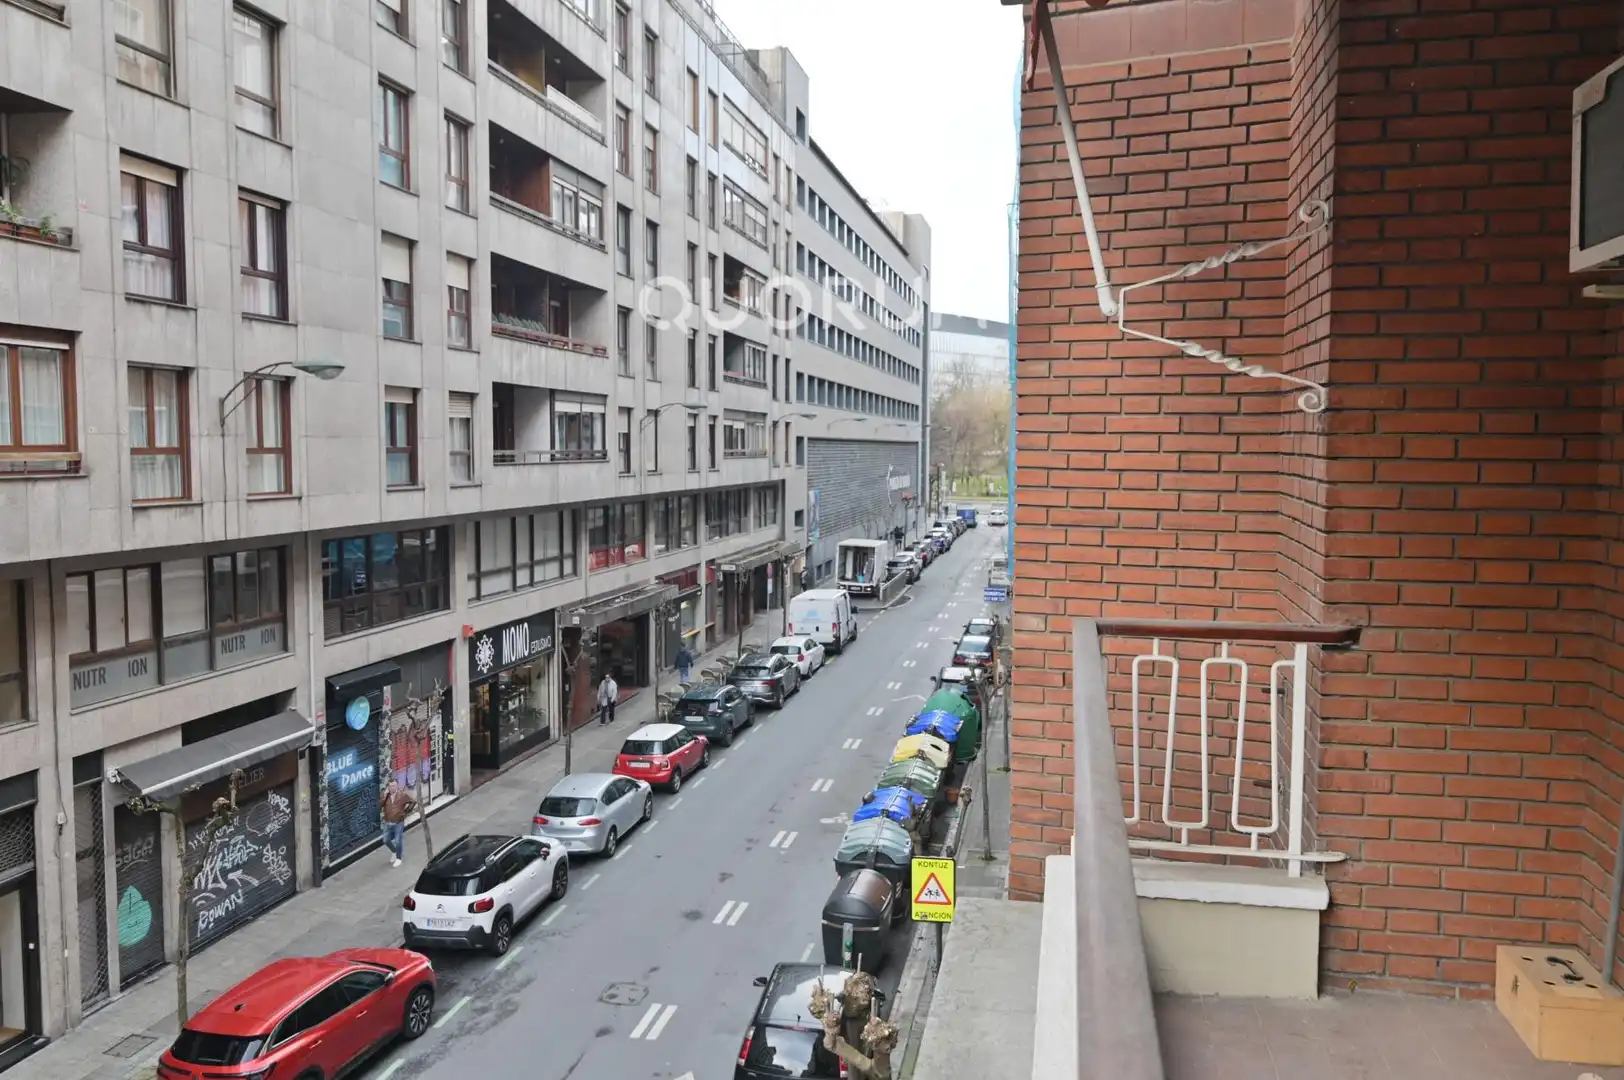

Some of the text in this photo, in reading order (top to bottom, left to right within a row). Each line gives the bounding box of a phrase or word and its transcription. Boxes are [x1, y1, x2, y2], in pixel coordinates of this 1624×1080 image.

[220, 635, 246, 654] NUTR
[502, 622, 529, 665] MOMO
[73, 667, 107, 691] NUTR
[918, 861, 948, 869] KONTUZ
